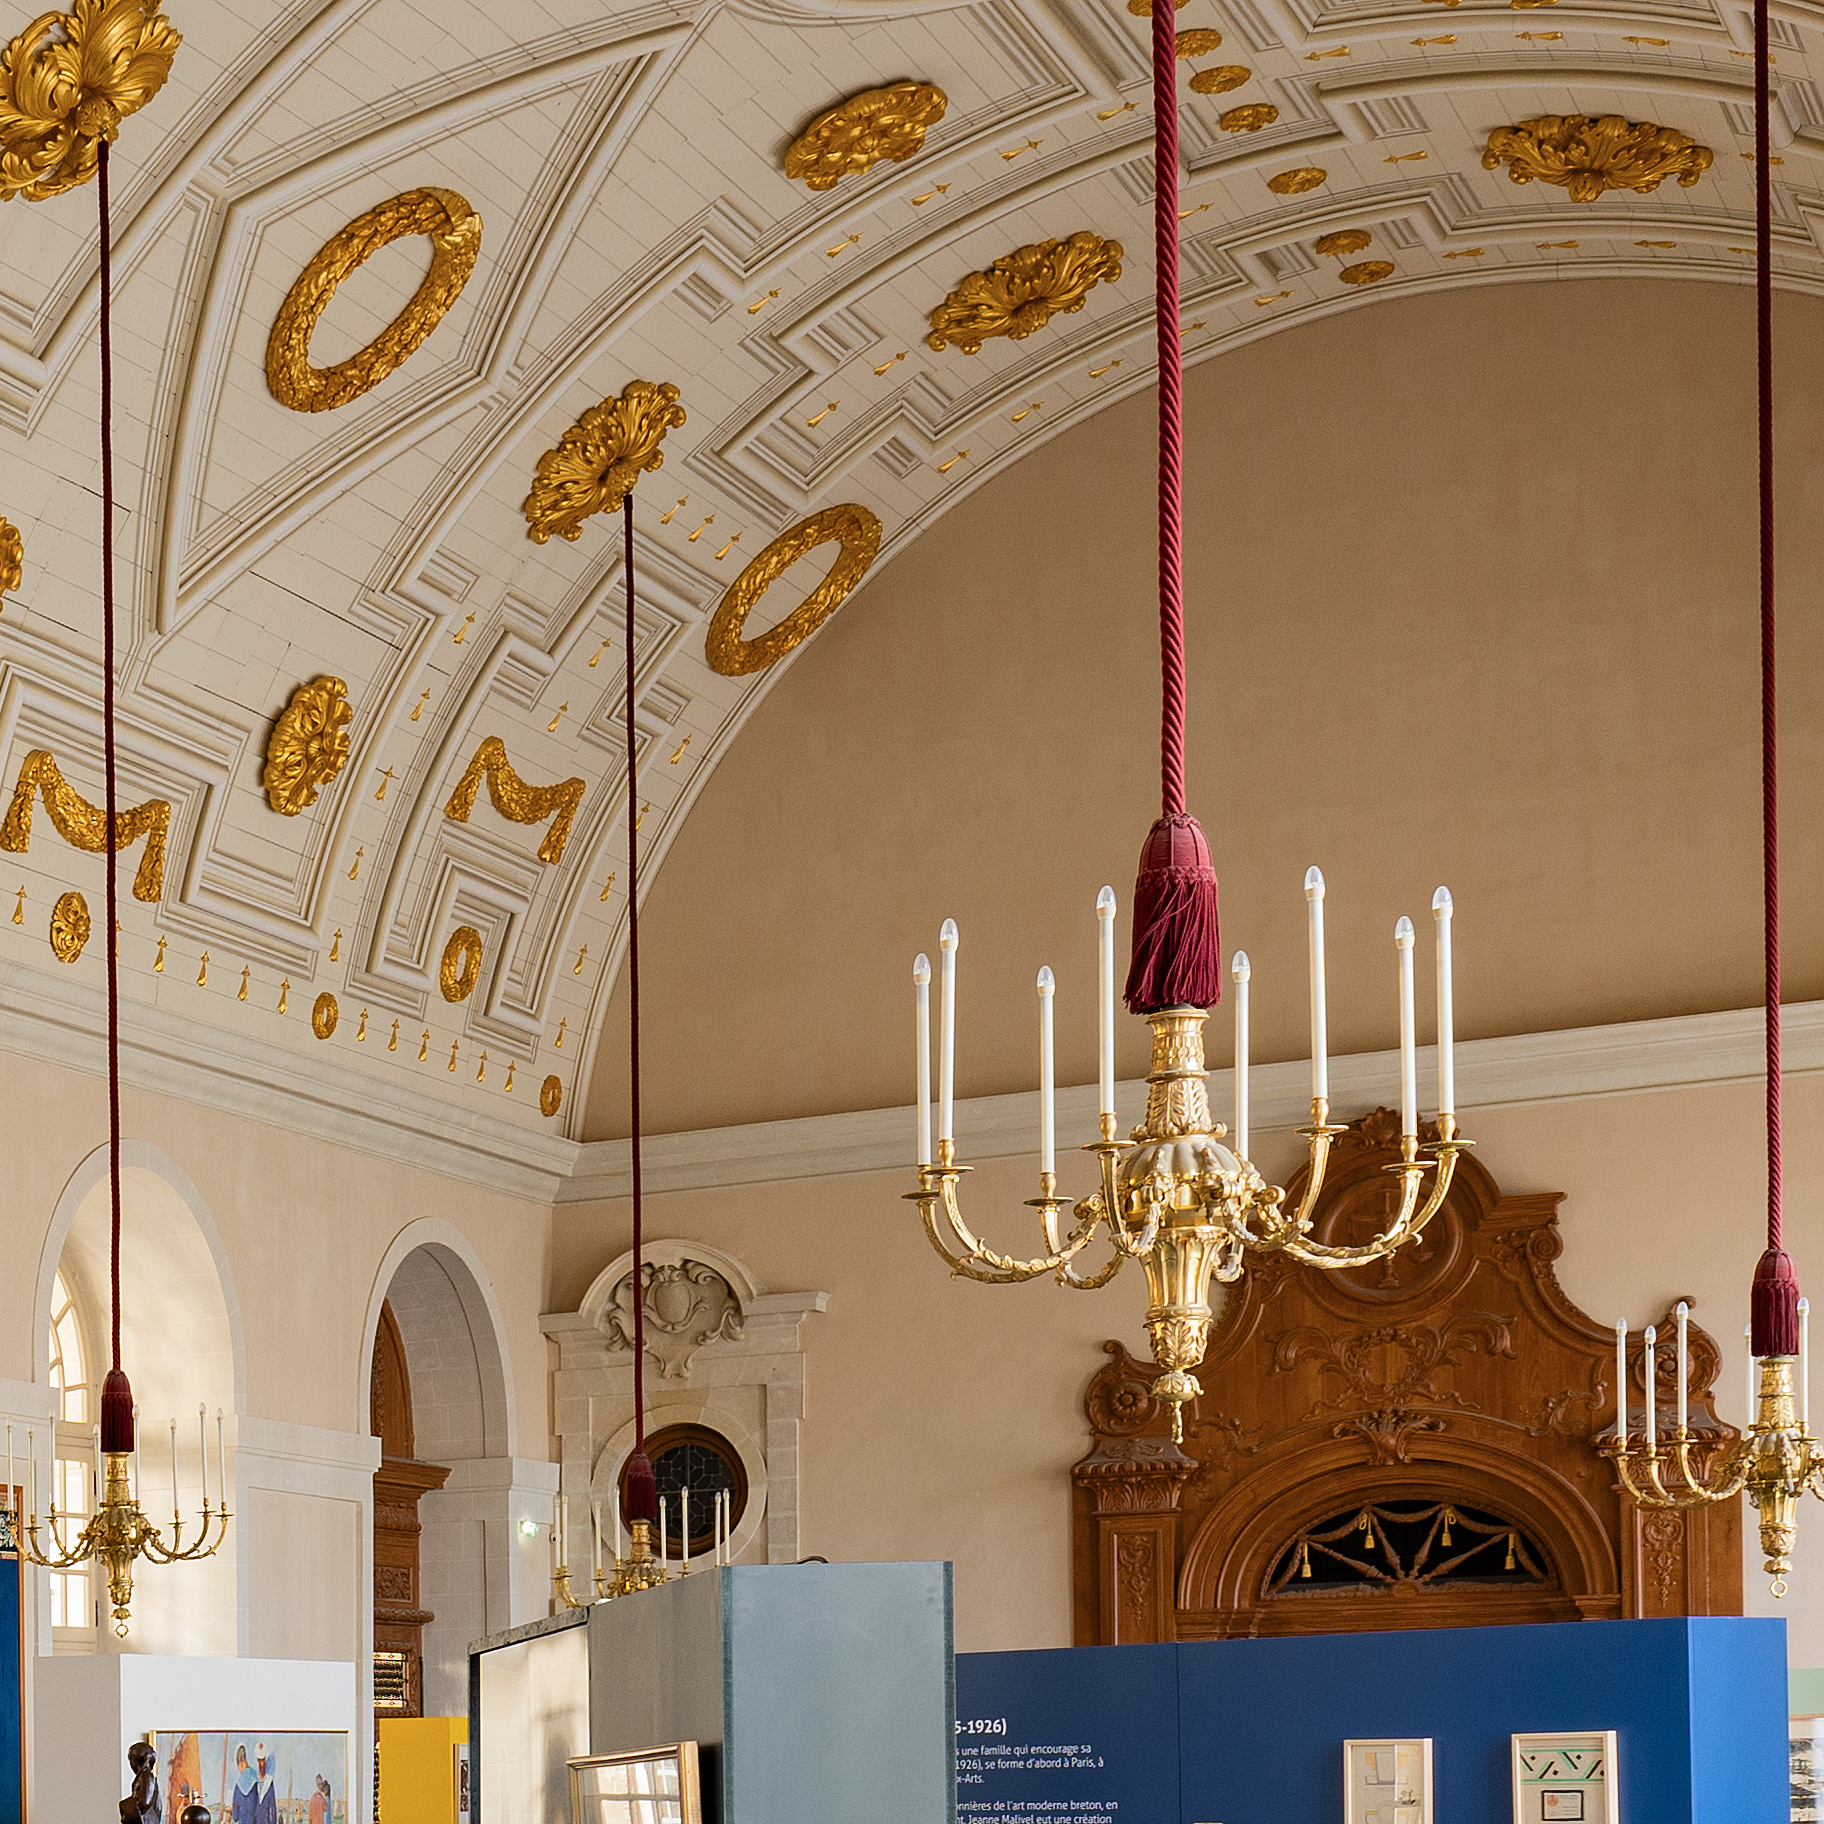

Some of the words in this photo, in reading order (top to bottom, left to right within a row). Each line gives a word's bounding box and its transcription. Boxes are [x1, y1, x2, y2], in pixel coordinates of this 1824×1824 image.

[961, 1748, 979, 1756] une
[980, 1744, 1012, 1756] famille
[1013, 1744, 1029, 1757] qui
[1030, 1745, 1079, 1757] encourage
[1080, 1745, 1092, 1754] sa
[984, 1761, 996, 1770] se
[997, 1758, 1024, 1769] forme
[1026, 1757, 1062, 1769] d'abord
[1063, 1757, 1070, 1768] à
[1071, 1757, 1096, 1768] Paris,
[1097, 1756, 1104, 1768] à
[993, 1800, 1005, 1811] de
[1006, 1800, 1026, 1811] l'art
[1026, 1800, 1068, 1811] moderne
[1070, 1799, 1104, 1811] breton,
[1105, 1801, 1118, 1810] en
[968, 1814, 1000, 1824] Jeanne
[1001, 1814, 1034, 1824] Malivel
[1036, 1815, 1052, 1824] eut
[1053, 1816, 1072, 1824] une
[1073, 1813, 1112, 1824] création
